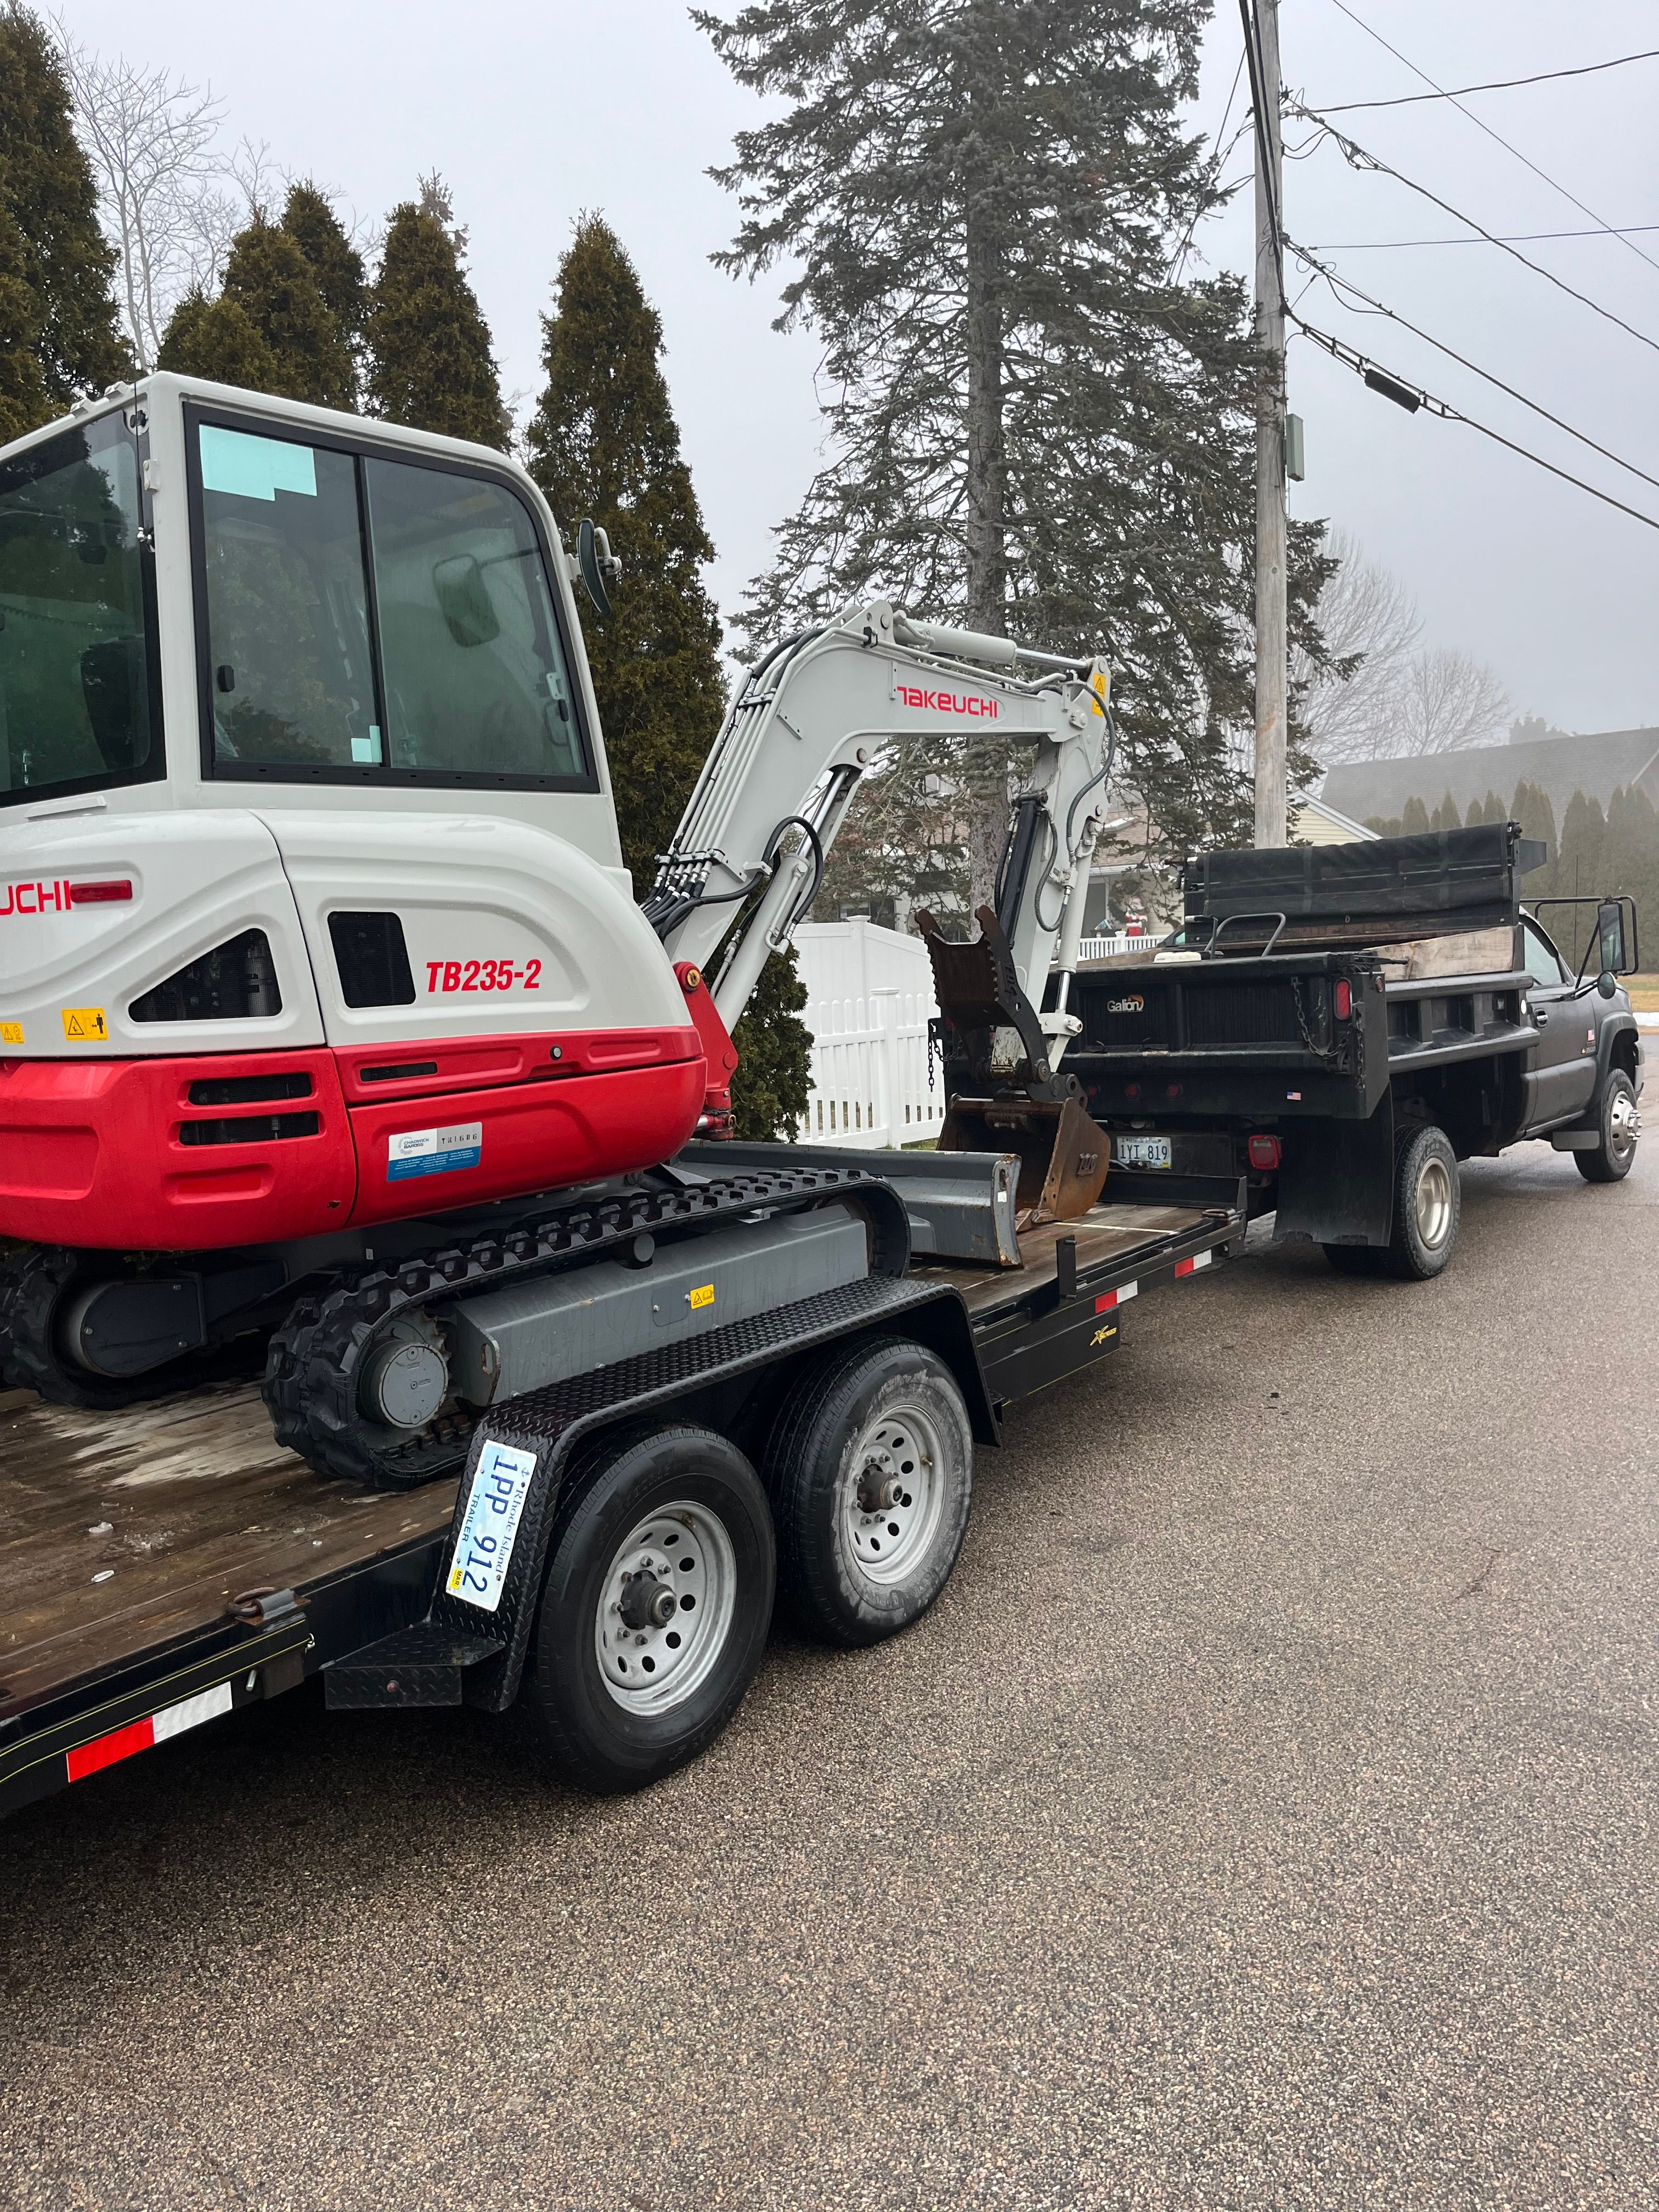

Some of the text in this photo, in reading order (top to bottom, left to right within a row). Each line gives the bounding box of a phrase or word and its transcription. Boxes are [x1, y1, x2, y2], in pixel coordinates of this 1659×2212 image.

[897, 686, 997, 718] TAKEUCHI
[426, 959, 541, 992] TB235-2
[1120, 1144, 1167, 1160] 1YI 819
[462, 1494, 480, 1542] TRAILER
[462, 1455, 518, 1592] 1PP 912
[495, 1489, 523, 1574] Rhode Island
[454, 1570, 462, 1585] MAR
